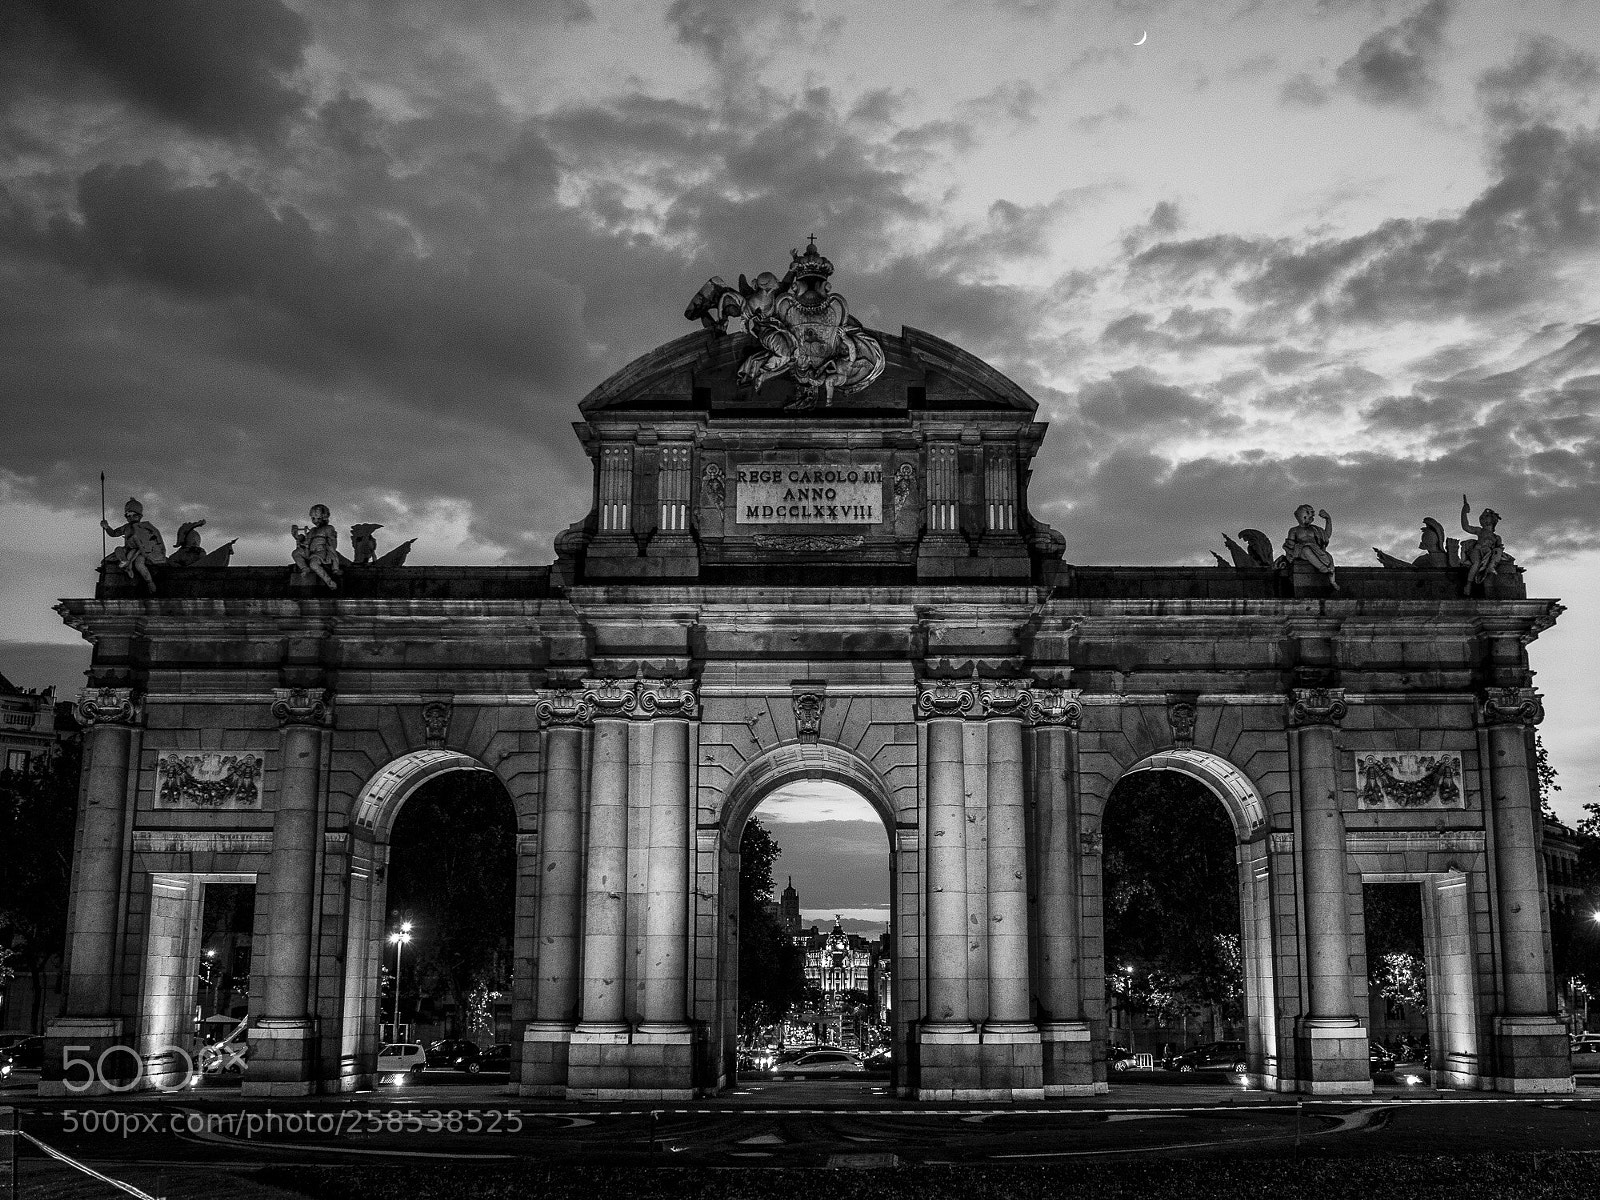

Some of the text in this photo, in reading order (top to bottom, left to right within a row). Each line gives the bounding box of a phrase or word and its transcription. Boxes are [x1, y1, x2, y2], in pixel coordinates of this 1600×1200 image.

[737, 470, 883, 483] REGE CAROLO III
[782, 487, 837, 500] ANNO
[745, 505, 873, 518] MDCCLXXVIII
